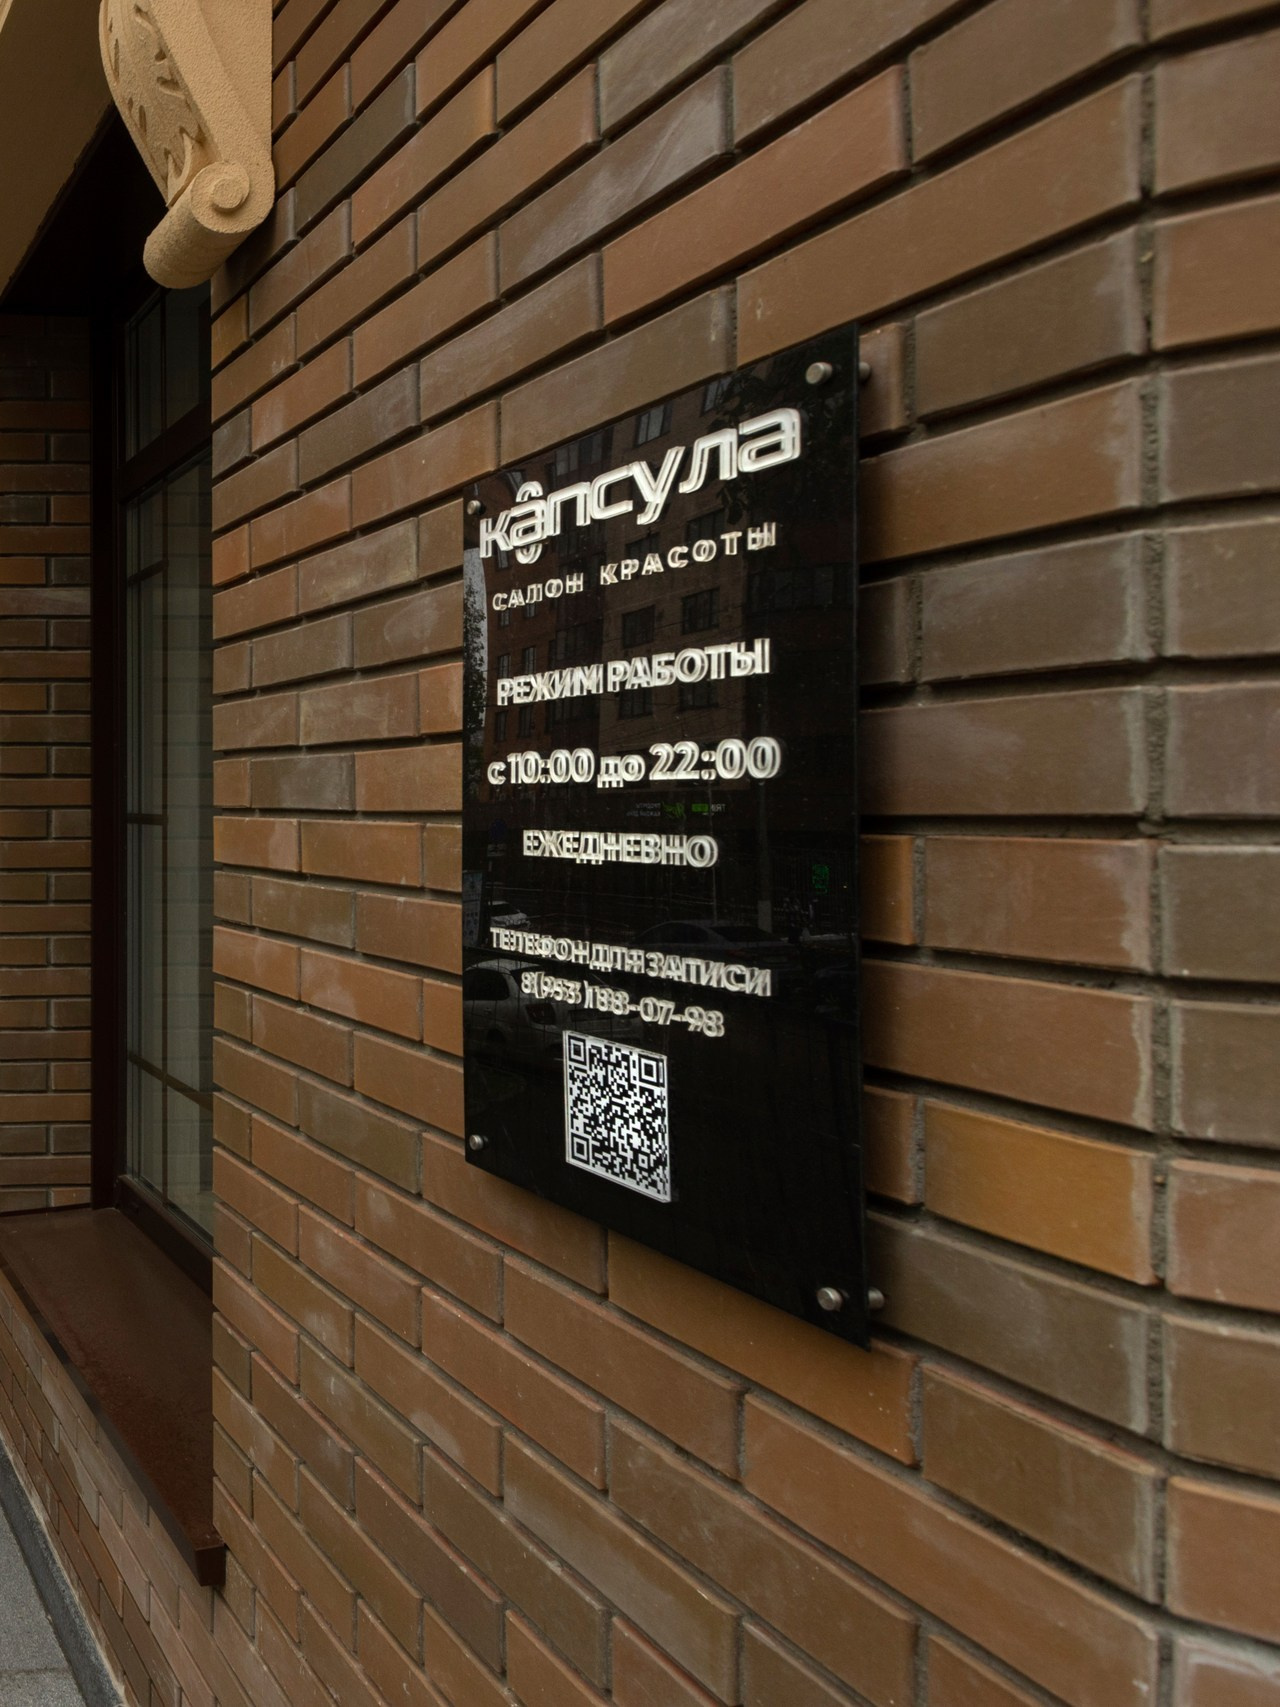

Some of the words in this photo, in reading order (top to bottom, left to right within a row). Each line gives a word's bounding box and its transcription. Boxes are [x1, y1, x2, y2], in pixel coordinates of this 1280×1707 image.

[493, 573, 583, 611] САЛОН
[600, 522, 777, 585] КРАСОТЫ
[497, 664, 604, 706] РЕЖИМ
[607, 638, 770, 692] РАБОТЫ
[507, 747, 595, 784] 10:00
[597, 755, 645, 788] до
[649, 737, 782, 780] 22:00
[523, 830, 718, 868] ЕЖЕДНЕВНО
[490, 927, 589, 964] ТЕЛЕФОН
[590, 943, 645, 974] ДЛЯ
[646, 952, 771, 996] ЗАПИСИ
